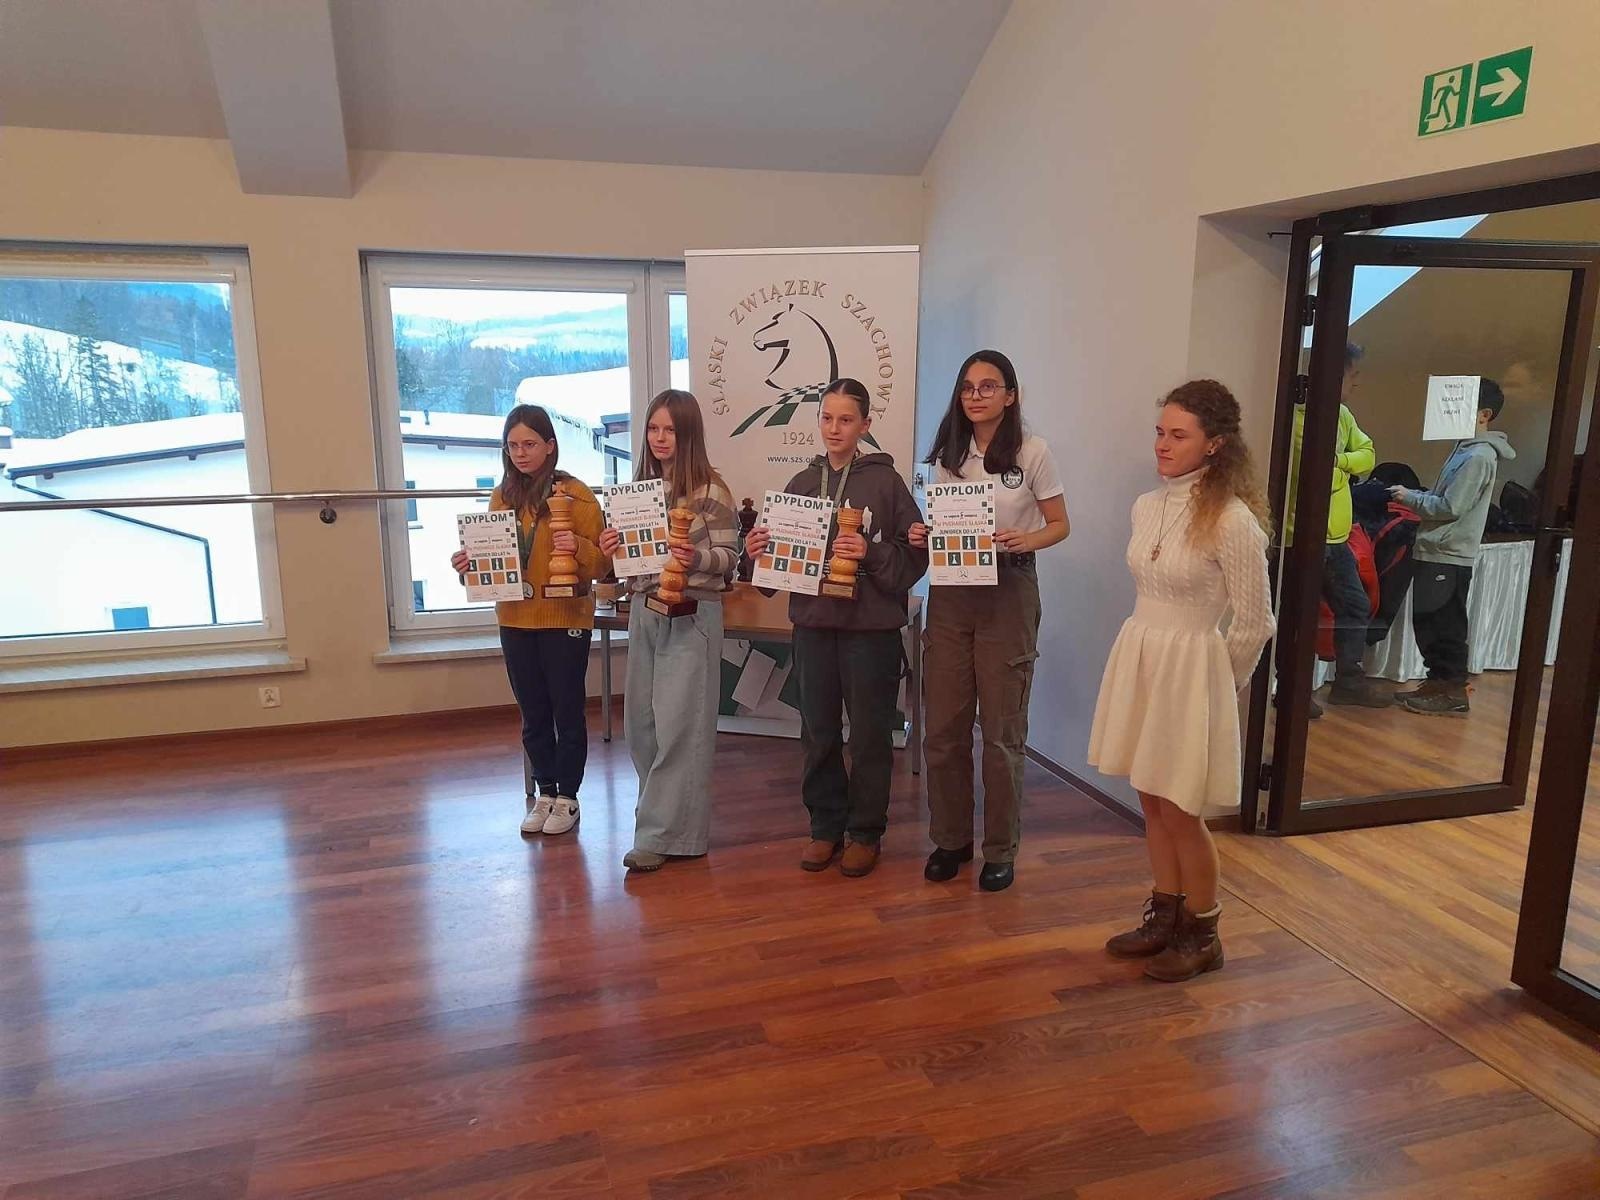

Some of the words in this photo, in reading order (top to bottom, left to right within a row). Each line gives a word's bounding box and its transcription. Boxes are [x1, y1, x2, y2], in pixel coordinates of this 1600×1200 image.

[729, 280, 828, 326] ZWIĄZEK
[841, 293, 895, 420] SZACHOWY
[781, 431, 815, 446] 1924
[611, 482, 655, 496] DYPLOM
[935, 484, 985, 497] DYPLOM
[774, 494, 824, 511] DYPLOM
[464, 513, 508, 525] DYPLOM
